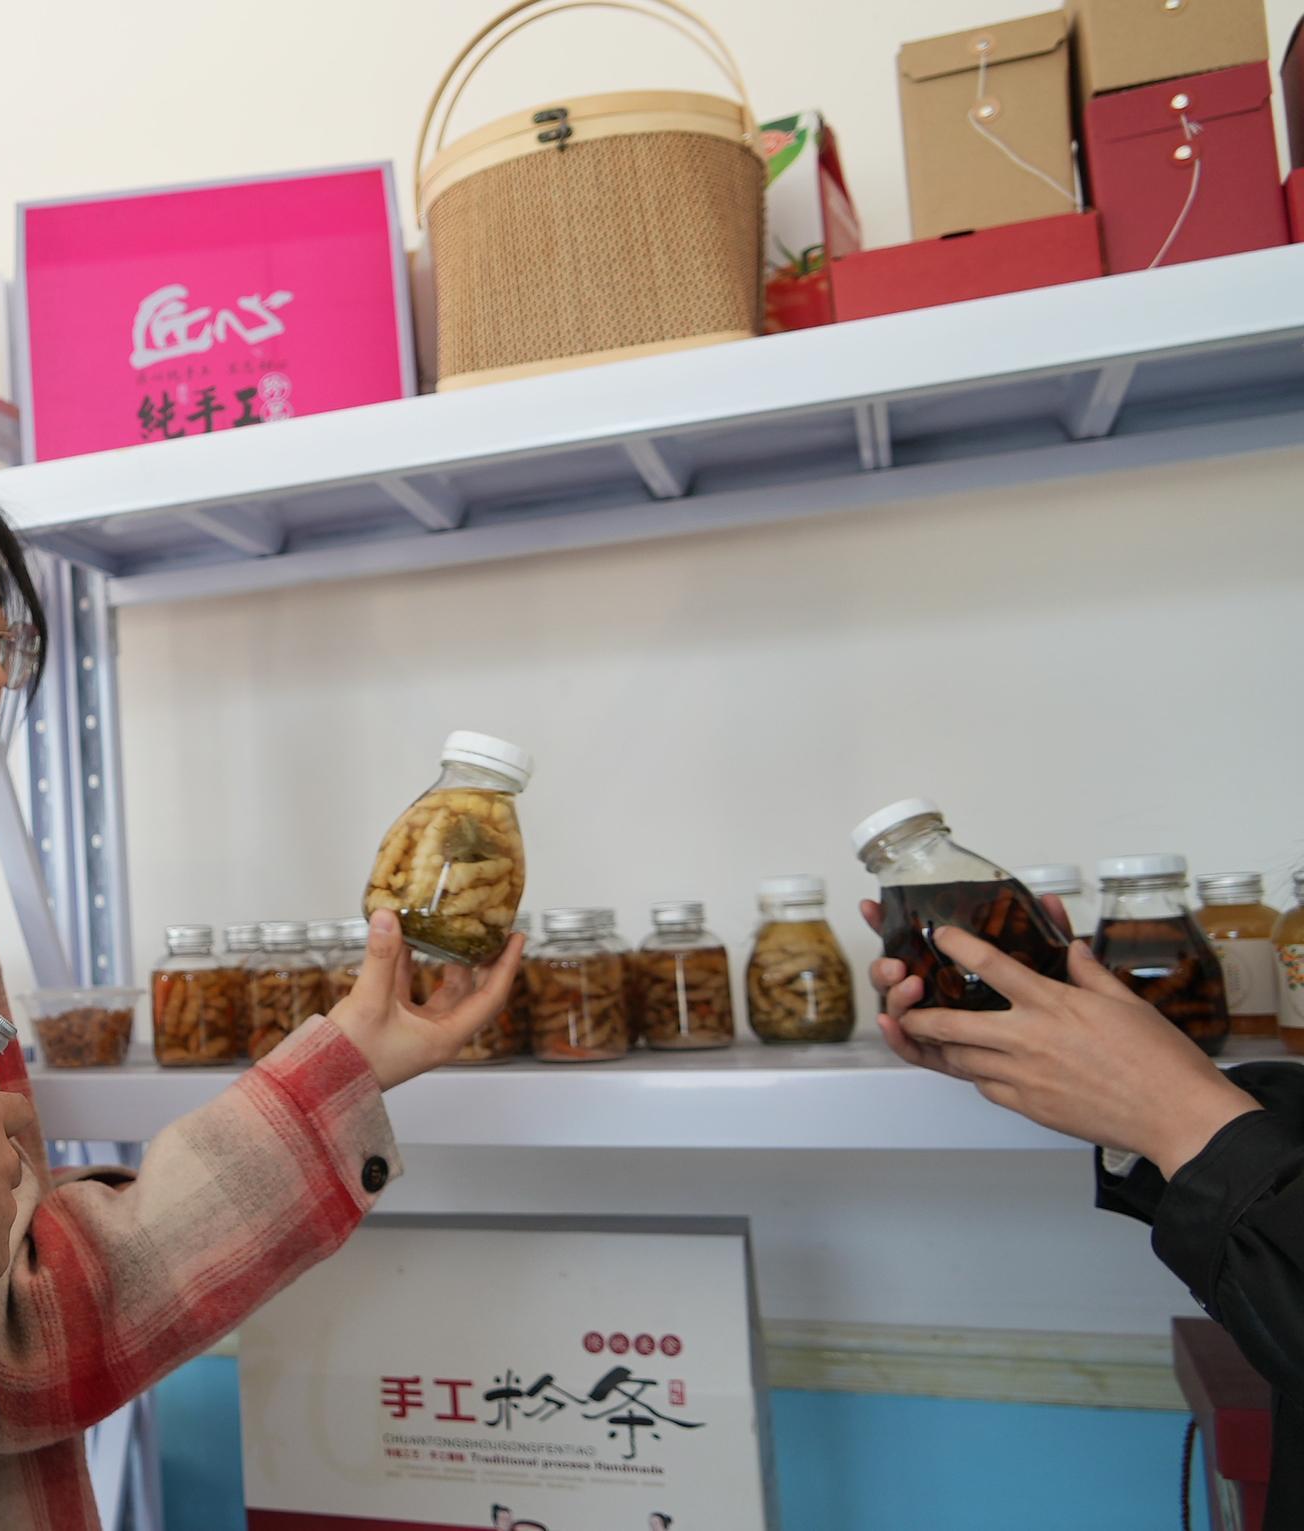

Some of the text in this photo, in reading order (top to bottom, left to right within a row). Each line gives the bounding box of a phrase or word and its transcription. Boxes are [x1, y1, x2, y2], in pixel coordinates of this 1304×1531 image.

[380, 1366, 706, 1460] 手工粉条
[470, 1453, 538, 1467] Traditional
